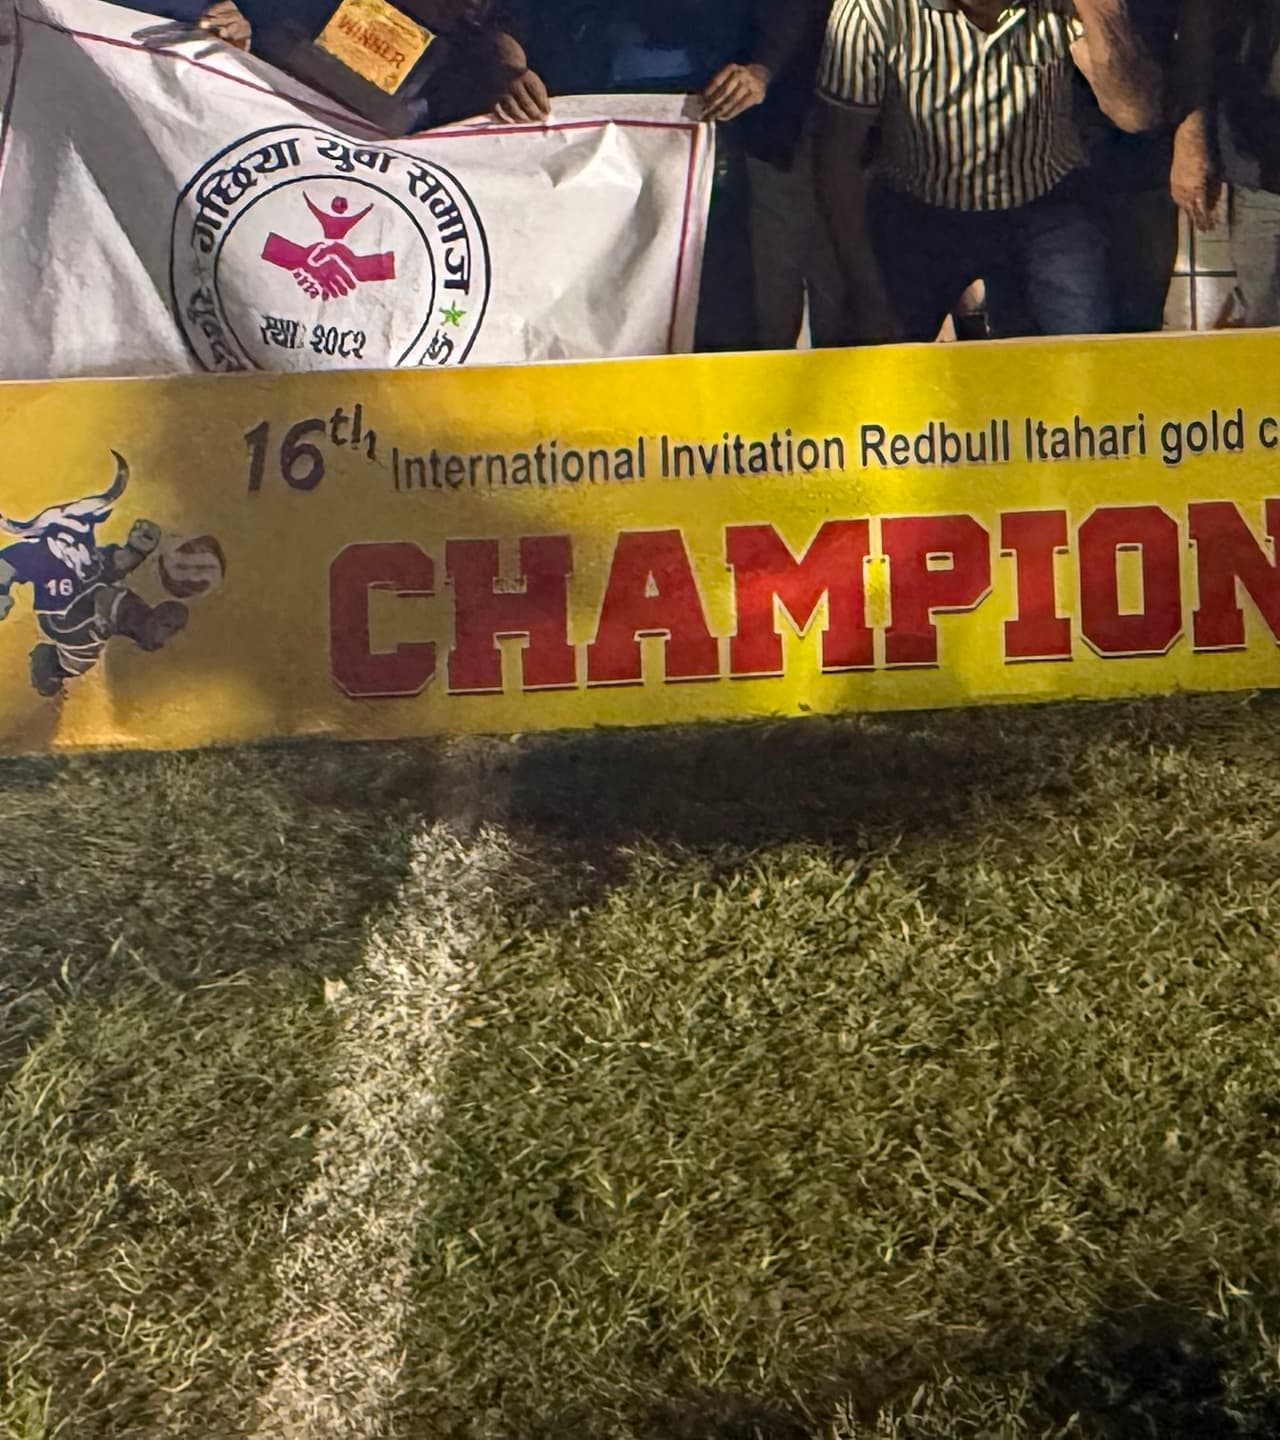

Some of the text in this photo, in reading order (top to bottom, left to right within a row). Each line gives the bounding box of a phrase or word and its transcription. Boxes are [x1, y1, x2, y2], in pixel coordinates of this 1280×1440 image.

[315, 136, 397, 173] युवा
[407, 162, 471, 296] समाज
[392, 436, 645, 492] International
[661, 426, 846, 482] Invitation
[861, 419, 1010, 469] Redbull
[1025, 413, 1146, 461] Itahari
[1161, 409, 1244, 466] gold
[47, 578, 74, 597] 16
